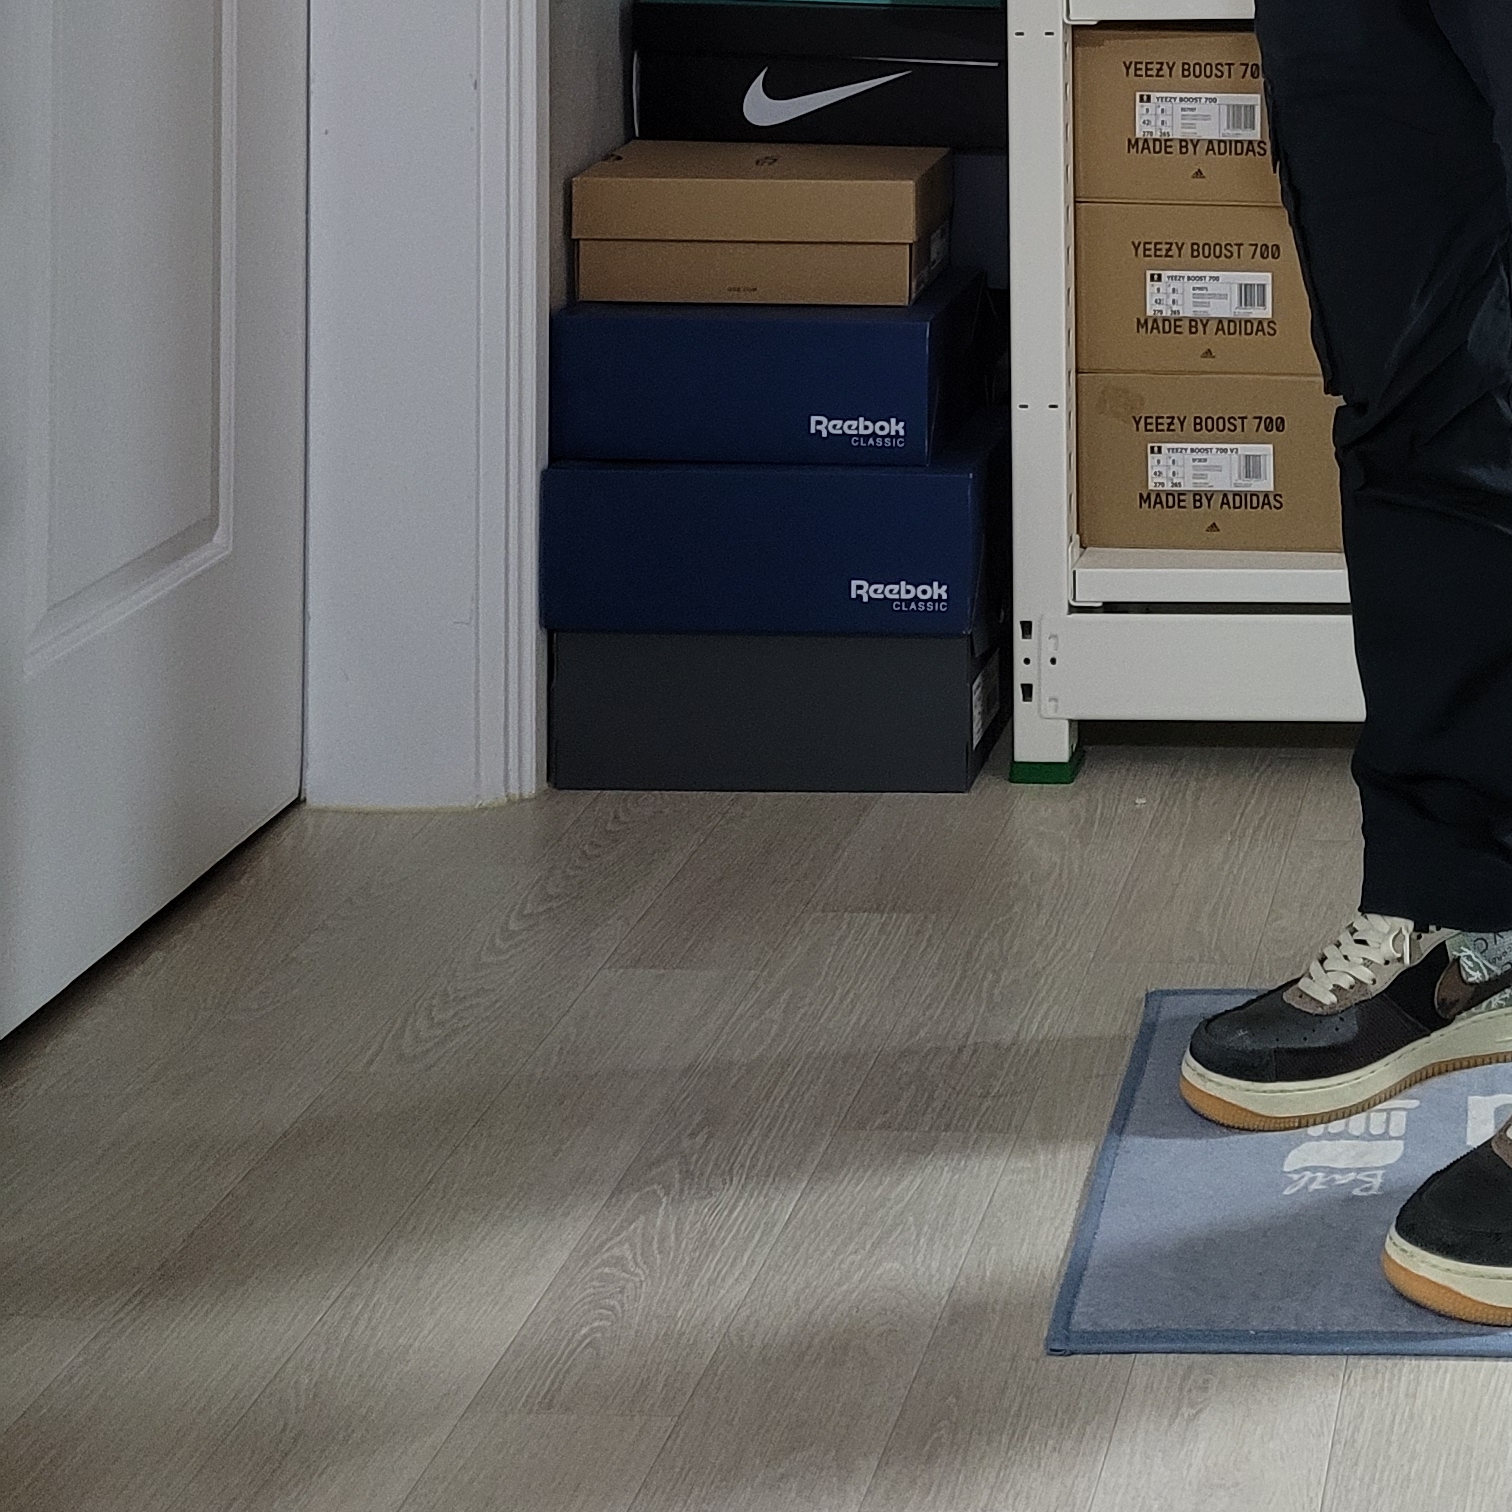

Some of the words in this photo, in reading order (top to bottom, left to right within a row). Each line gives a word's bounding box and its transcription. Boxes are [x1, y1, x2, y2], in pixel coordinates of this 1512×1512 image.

[1122, 60, 1176, 78] YEEZY
[1181, 62, 1235, 79] BOOST
[1240, 63, 1260, 80] 70
[1127, 138, 1173, 155] MADE
[1178, 139, 1200, 156] BY
[1205, 140, 1267, 157] ADIDAS
[1131, 241, 1185, 259] YEEZY
[1190, 242, 1245, 259] BOOST
[1248, 243, 1281, 260] 700
[1136, 317, 1184, 335] MADE
[1188, 318, 1210, 336] BY
[1214, 319, 1278, 337] ADIDAS
[810, 416, 905, 437] Reebok
[1131, 415, 1187, 433] YEEZY
[1193, 416, 1249, 433] BOOST
[1252, 416, 1286, 433] 700
[850, 437, 905, 449] CLASSIC
[1138, 492, 1187, 509] MADE
[1192, 493, 1214, 510] BY
[1219, 493, 1284, 511] ADIDAS
[850, 580, 947, 602] Reebok
[892, 601, 947, 612] CLASSIC
